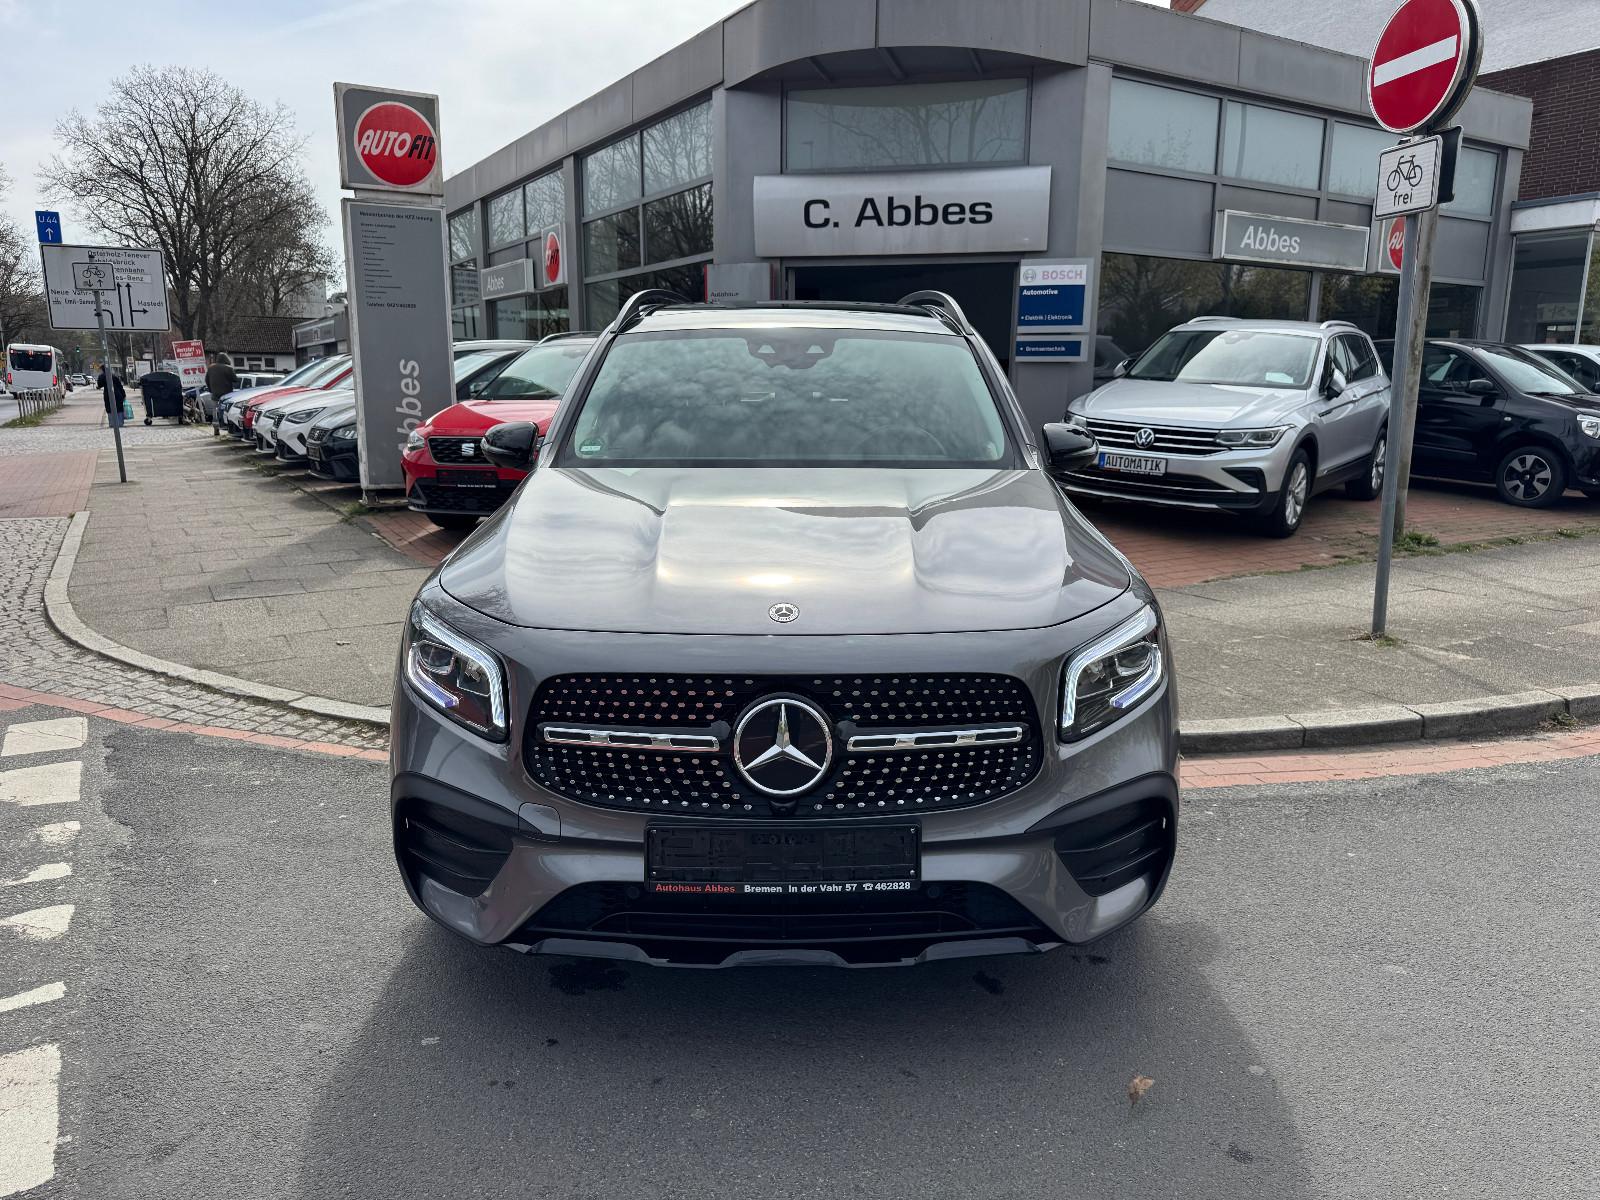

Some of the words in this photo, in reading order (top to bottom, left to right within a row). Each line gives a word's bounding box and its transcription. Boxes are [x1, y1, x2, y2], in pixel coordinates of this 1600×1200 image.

[359, 128, 435, 160] AUTOFIT
[1392, 188, 1413, 207] frei
[38, 215, 45, 223] U
[46, 215, 58, 224] 44
[803, 199, 840, 228] C.
[854, 195, 993, 227] Abbes
[1240, 225, 1301, 254] Abbes
[1041, 270, 1083, 280] BOSCH
[1022, 288, 1059, 296] Automotive
[395, 359, 422, 452] bbes
[1105, 455, 1162, 472] AUTOMATIK
[655, 883, 702, 892] Autohaus
[704, 884, 736, 893] Abbes
[743, 884, 783, 893] Bremen
[788, 884, 798, 893] In
[800, 884, 818, 893] der
[819, 883, 843, 892] Vahr
[845, 883, 858, 892] 57
